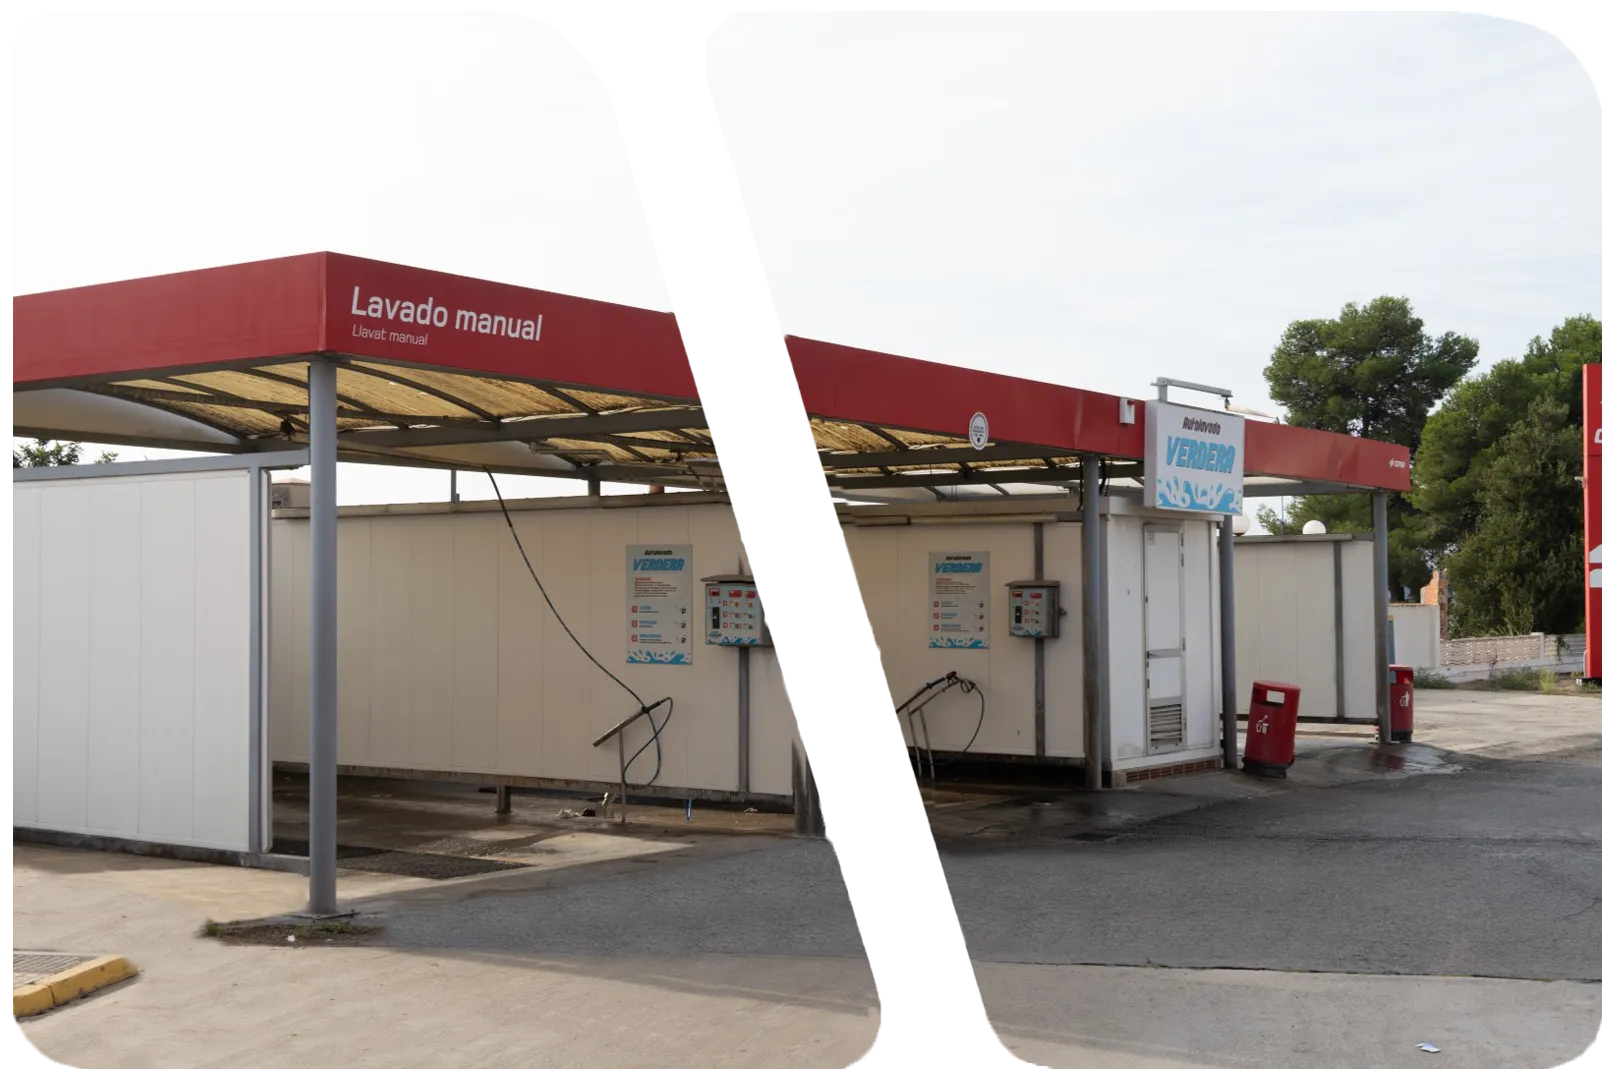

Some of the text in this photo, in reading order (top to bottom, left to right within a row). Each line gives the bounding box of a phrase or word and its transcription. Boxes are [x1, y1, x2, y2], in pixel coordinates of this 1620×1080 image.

[351, 286, 544, 342] Lavado manual
[352, 324, 429, 346] Llavat manual
[1182, 416, 1221, 435] Autolavado
[1166, 434, 1236, 474] VERDERA
